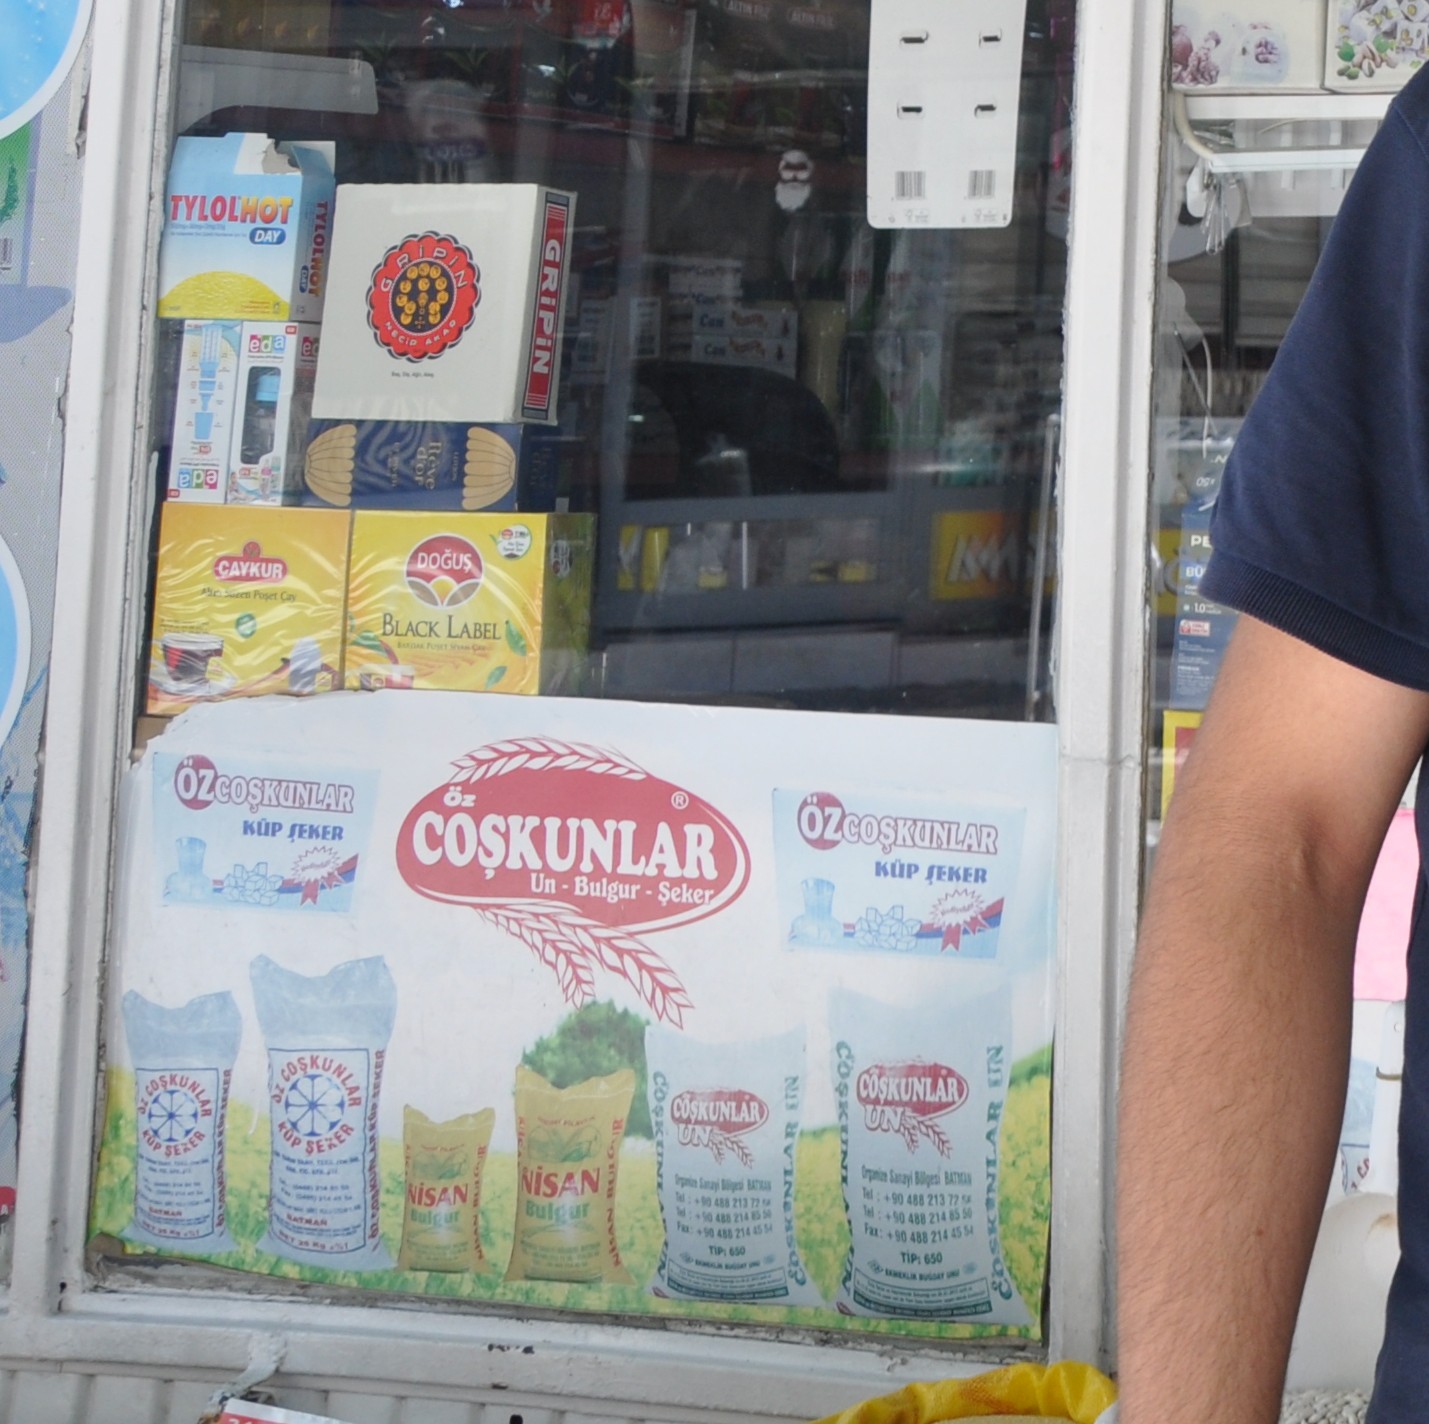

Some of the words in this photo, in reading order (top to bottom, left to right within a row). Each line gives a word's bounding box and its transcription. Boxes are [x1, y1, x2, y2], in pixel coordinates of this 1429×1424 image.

[255, 231, 281, 243] DAY
[250, 336, 285, 353] eda
[417, 548, 472, 574] DOĞUŞ
[382, 612, 441, 639] BLACK
[446, 614, 502, 641] LABEL
[443, 786, 476, 807] Öz
[242, 818, 283, 840] KÜP
[286, 823, 344, 843] ŞEKER
[412, 811, 718, 881] COŞKUNLAR
[875, 860, 919, 879] KÜP
[925, 864, 988, 885] ŞEKER
[530, 874, 557, 895] Un
[574, 877, 641, 903] Bulgur
[658, 882, 715, 907] Şeker
[281, 1054, 362, 1108] COŞKUNLAR
[864, 1105, 901, 1132] UN
[278, 1120, 302, 1148] KÜP
[678, 1123, 711, 1147] UN
[521, 1165, 601, 1198] NİSAN
[889, 1168, 913, 1188] Sanayi
[914, 1169, 941, 1188] Bölgesi
[408, 1182, 468, 1208] NİSAN
[714, 1197, 730, 1208] 488
[884, 1193, 903, 1207] +90
[906, 1194, 924, 1207] 488
[927, 1193, 945, 1207] 213
[410, 1209, 459, 1227] Bulgur
[526, 1200, 590, 1224] Bulgur
[733, 1211, 749, 1223] 214
[885, 1211, 905, 1225] +90
[908, 1211, 926, 1225] 488
[929, 1210, 947, 1224] 214
[717, 1228, 733, 1240] 488
[735, 1226, 751, 1238] 214
[887, 1230, 907, 1243] +90
[910, 1231, 928, 1244] 488
[930, 1229, 949, 1242] 214
[951, 1228, 962, 1240] 45
[729, 1244, 746, 1256] 650
[924, 1251, 943, 1264] 650
